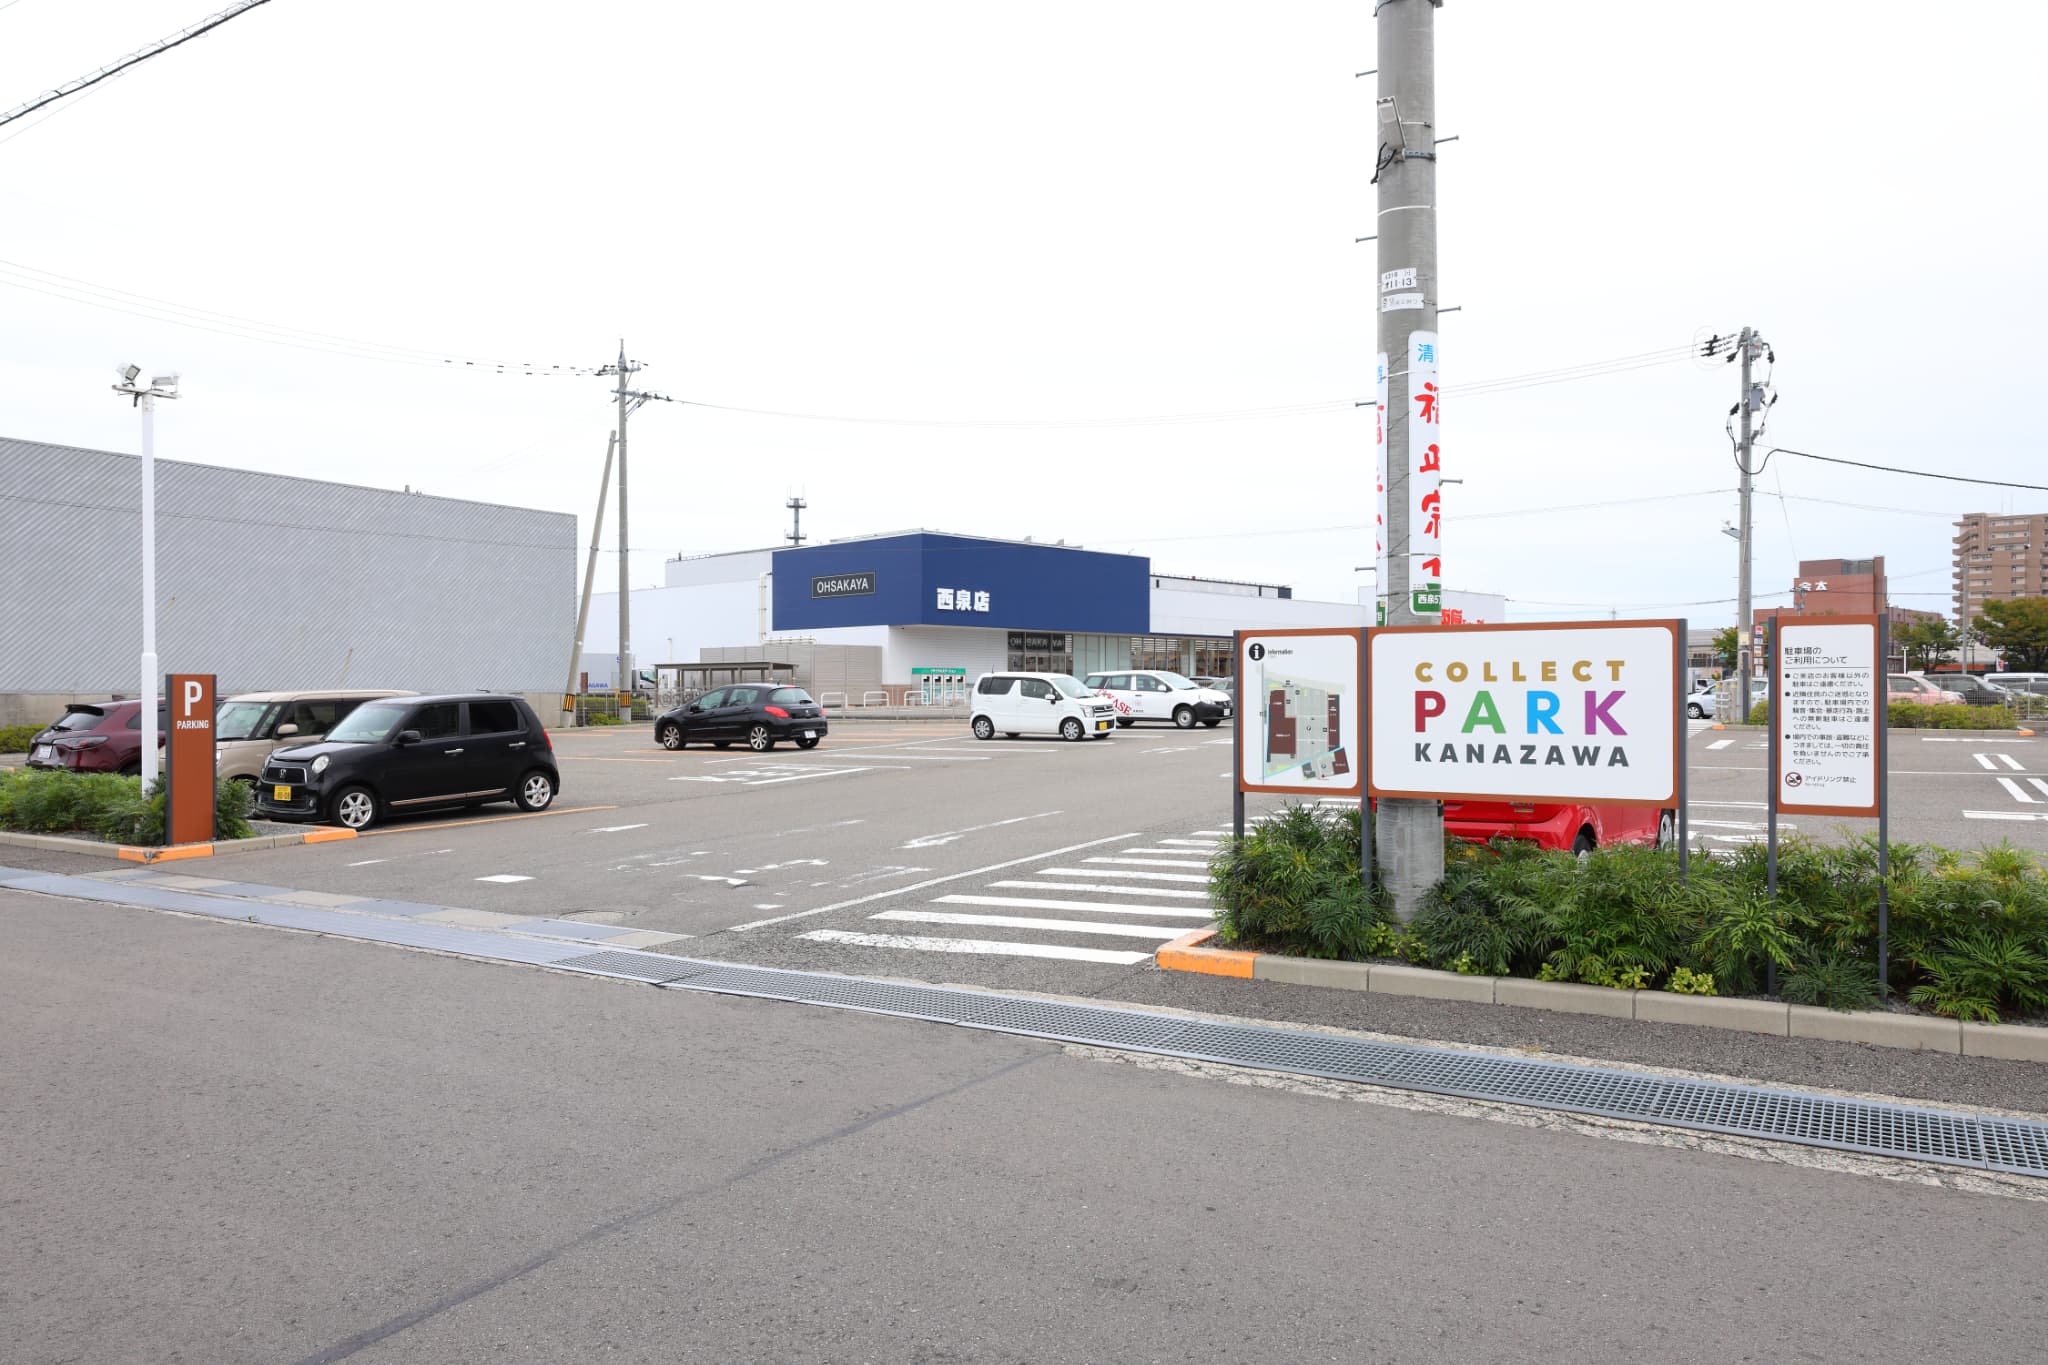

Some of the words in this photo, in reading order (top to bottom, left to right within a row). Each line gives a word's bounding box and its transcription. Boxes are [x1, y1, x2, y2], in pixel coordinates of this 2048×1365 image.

[816, 577, 868, 594] OHSAKAYA
[936, 588, 990, 612] 西泉店
[1784, 647, 1822, 655] 駐車場の
[1784, 656, 1848, 664] ご利用について
[1415, 660, 1625, 682] COLLECT
[184, 680, 202, 716] P
[1415, 690, 1628, 735] PARK
[176, 720, 208, 729] PARKING
[1415, 743, 1629, 767] KANAZAWA
[1805, 776, 1856, 784] アイドリング禁止
